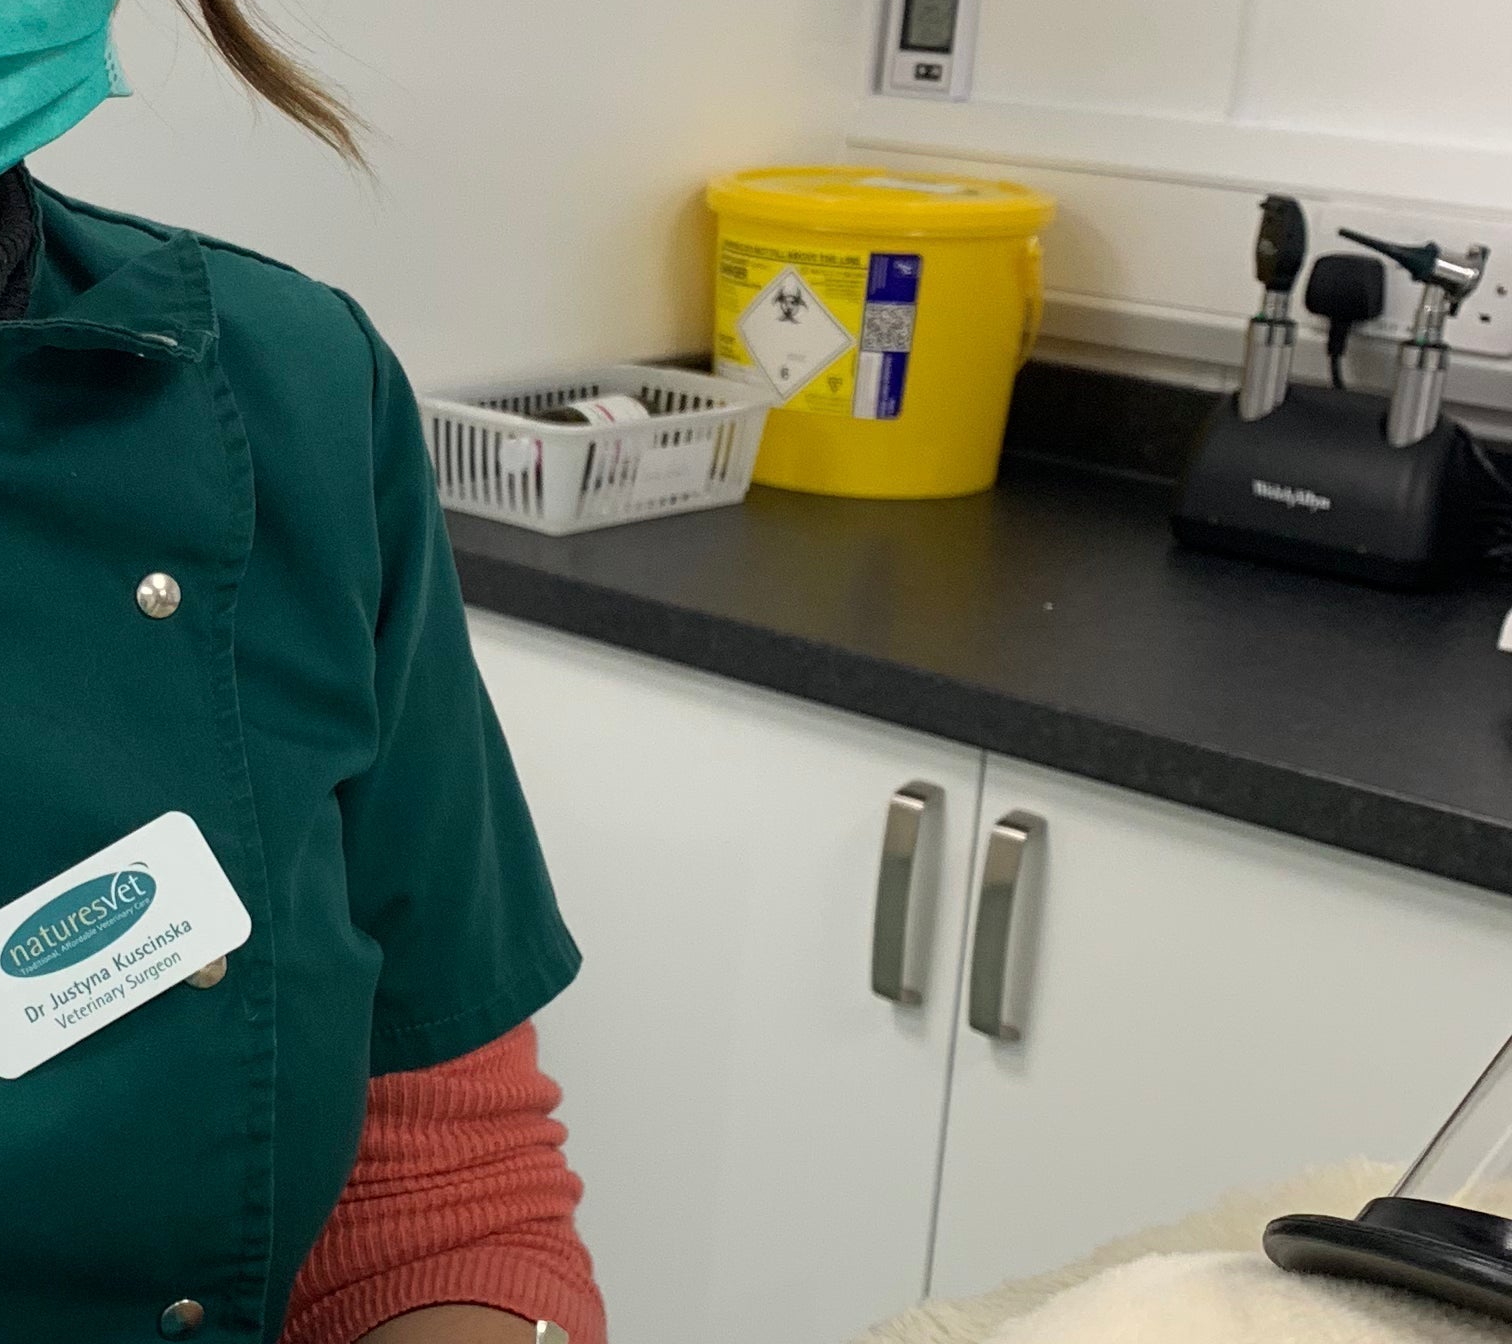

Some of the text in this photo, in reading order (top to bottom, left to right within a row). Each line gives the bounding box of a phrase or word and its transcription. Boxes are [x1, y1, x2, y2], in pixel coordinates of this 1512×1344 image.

[9, 870, 147, 967] naturesvet
[61, 928, 98, 953] Affordable
[96, 907, 134, 932] Veterinary
[134, 897, 152, 911] Care
[24, 920, 193, 1023] Dr Justyna Kuscinska
[54, 952, 183, 1030] Veterinary Surgeon
